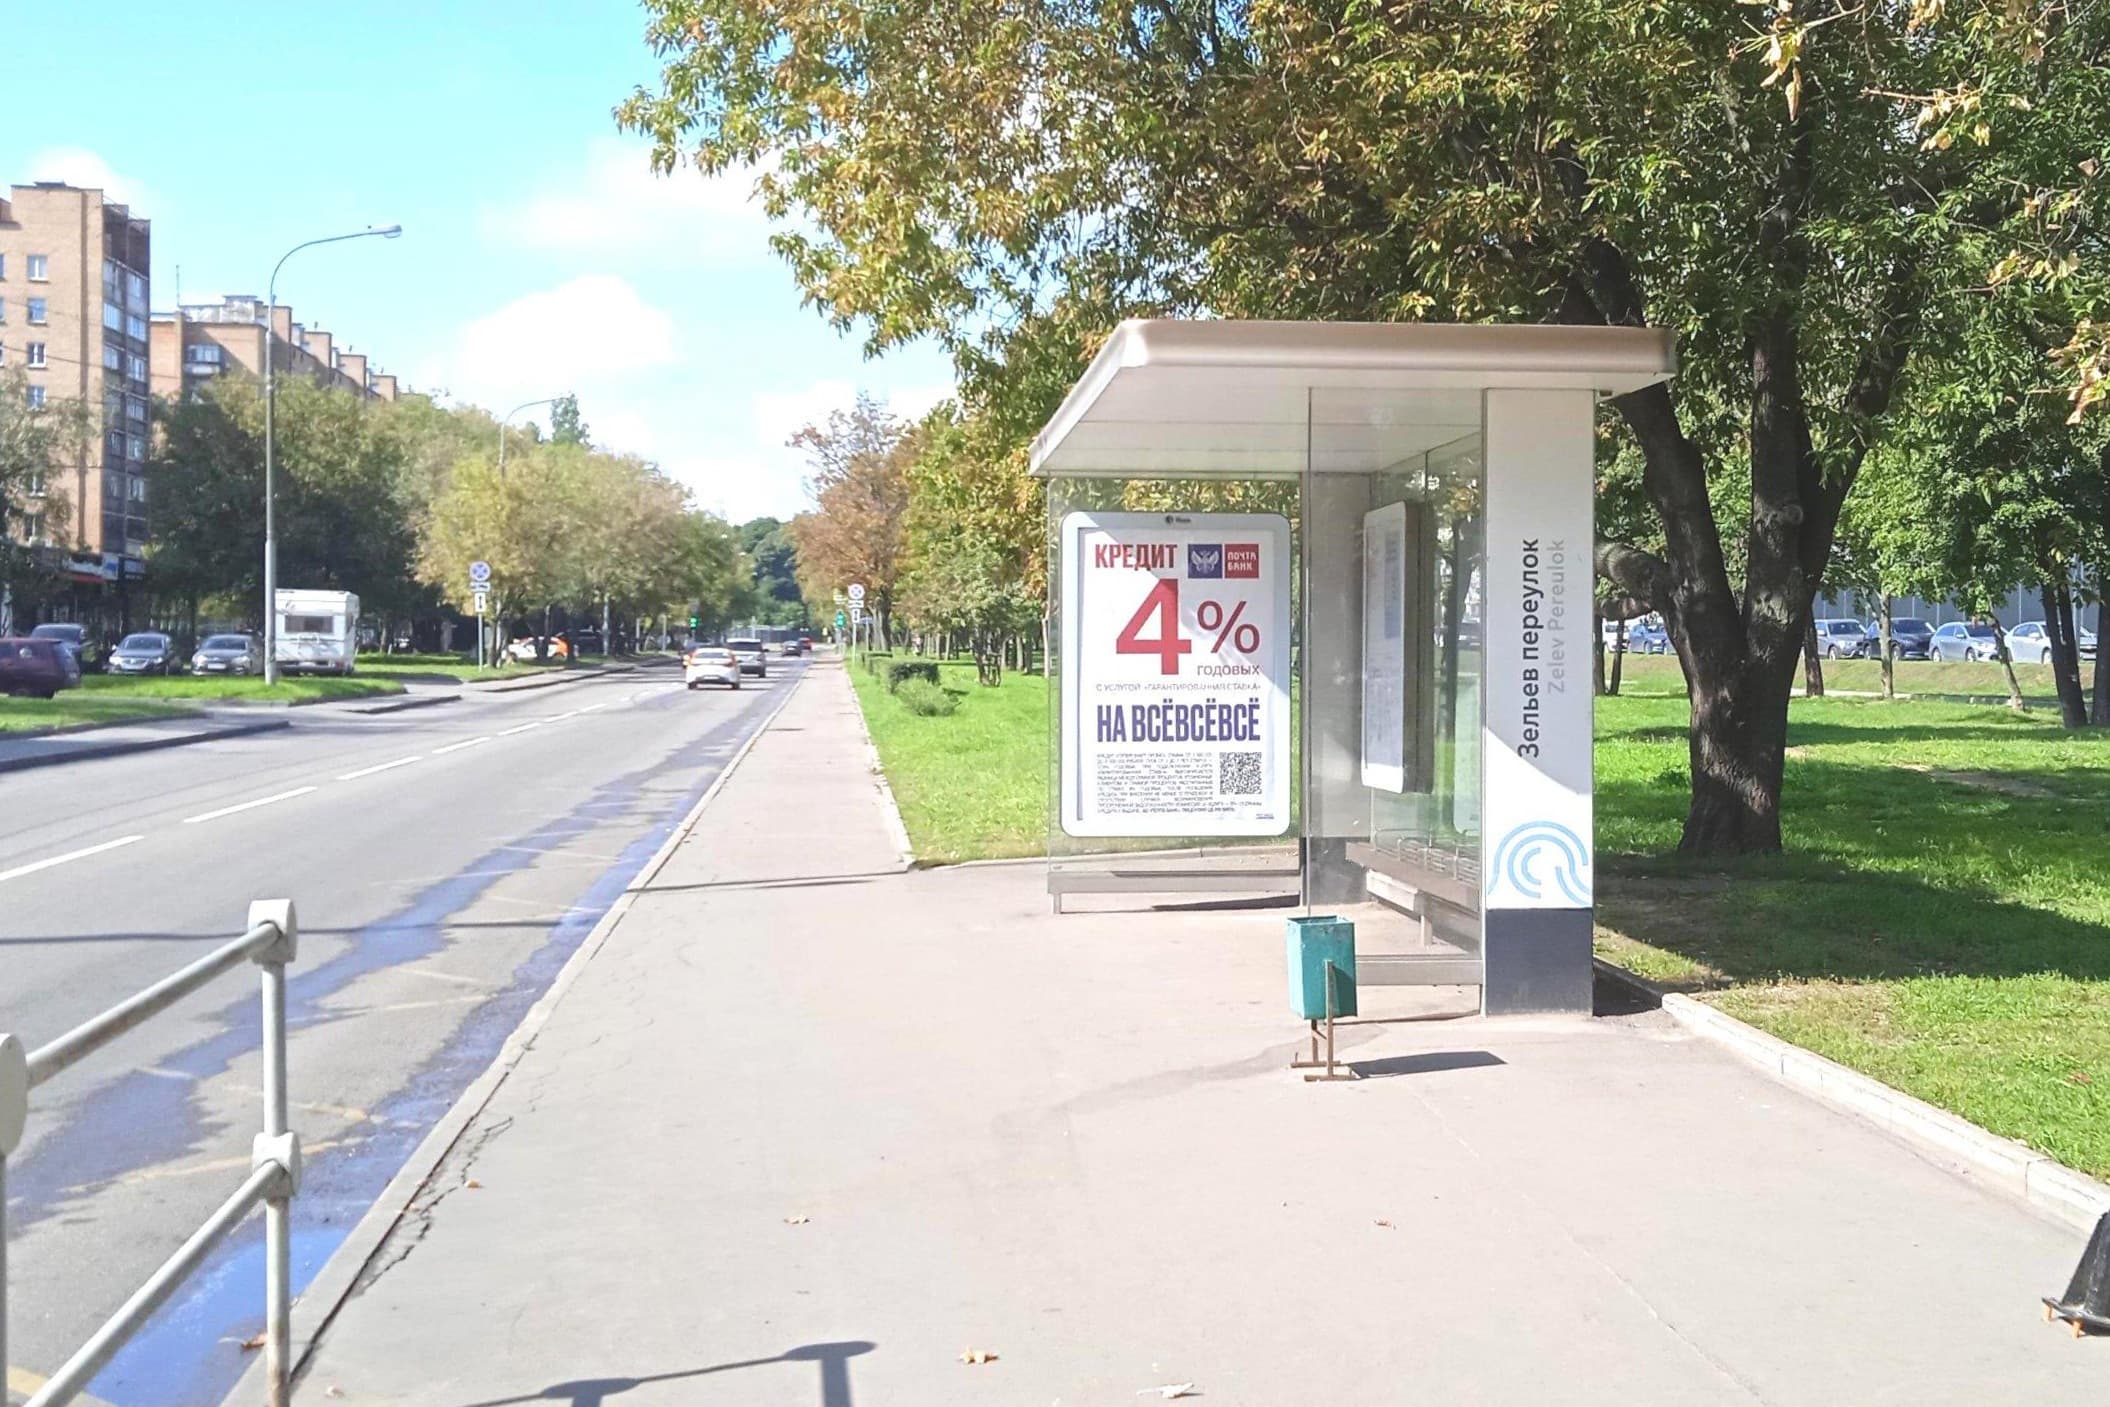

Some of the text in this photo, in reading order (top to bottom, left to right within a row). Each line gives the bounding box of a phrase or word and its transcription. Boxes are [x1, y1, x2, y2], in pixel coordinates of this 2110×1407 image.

[1095, 544, 1177, 570] КРЕДИТ
[1227, 552, 1257, 560] ПОЧТА
[1227, 562, 1253, 571] БАНК
[1548, 539, 1566, 694] Zelev Pereulok
[1517, 538, 1544, 758] Зельев переулок
[1096, 683, 1102, 691] С
[1105, 683, 1141, 691] УСЛУГОЙ
[1097, 698, 1260, 742] НА ВСЁВСЁВСЁ
